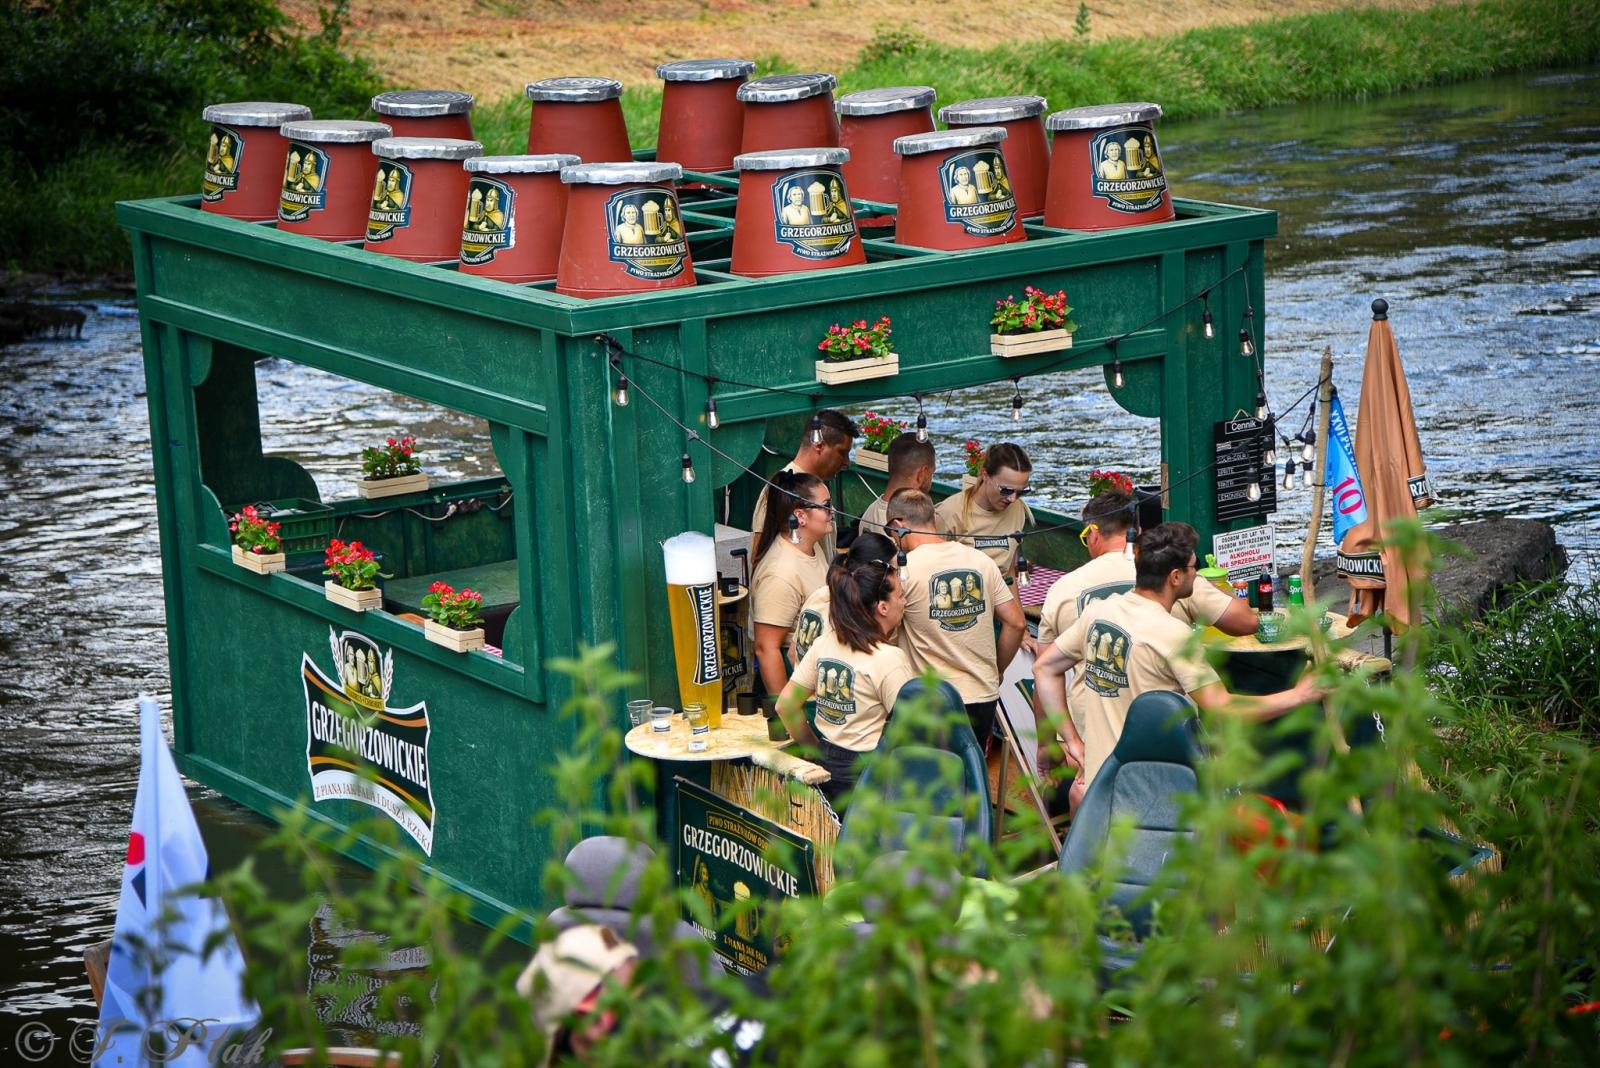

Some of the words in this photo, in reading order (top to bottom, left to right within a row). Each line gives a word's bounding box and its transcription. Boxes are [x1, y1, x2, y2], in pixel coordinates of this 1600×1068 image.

[1097, 176, 1165, 191] GRZEGORZOWICKIE
[949, 197, 1016, 217] GRZEGORZOWICKIE
[780, 222, 854, 238] GRZEGORZOWICKIE
[613, 241, 687, 257] GRZEGORZOWICKIE
[630, 267, 644, 276] PIWO
[1231, 420, 1257, 431] Cennik
[1333, 476, 1363, 515] 10
[1230, 549, 1261, 559] ALKOHOLU
[1231, 553, 1271, 566] SPRZEDAJEMY
[931, 603, 984, 617] GRZEGORZOWICKIE
[699, 586, 718, 680] GRZEGORZOWICKIE
[311, 701, 427, 789] GRZEGORZOWICKIE
[406, 817, 431, 851] RZEKI
[683, 824, 800, 899] GRZEGORZOWICKIE
